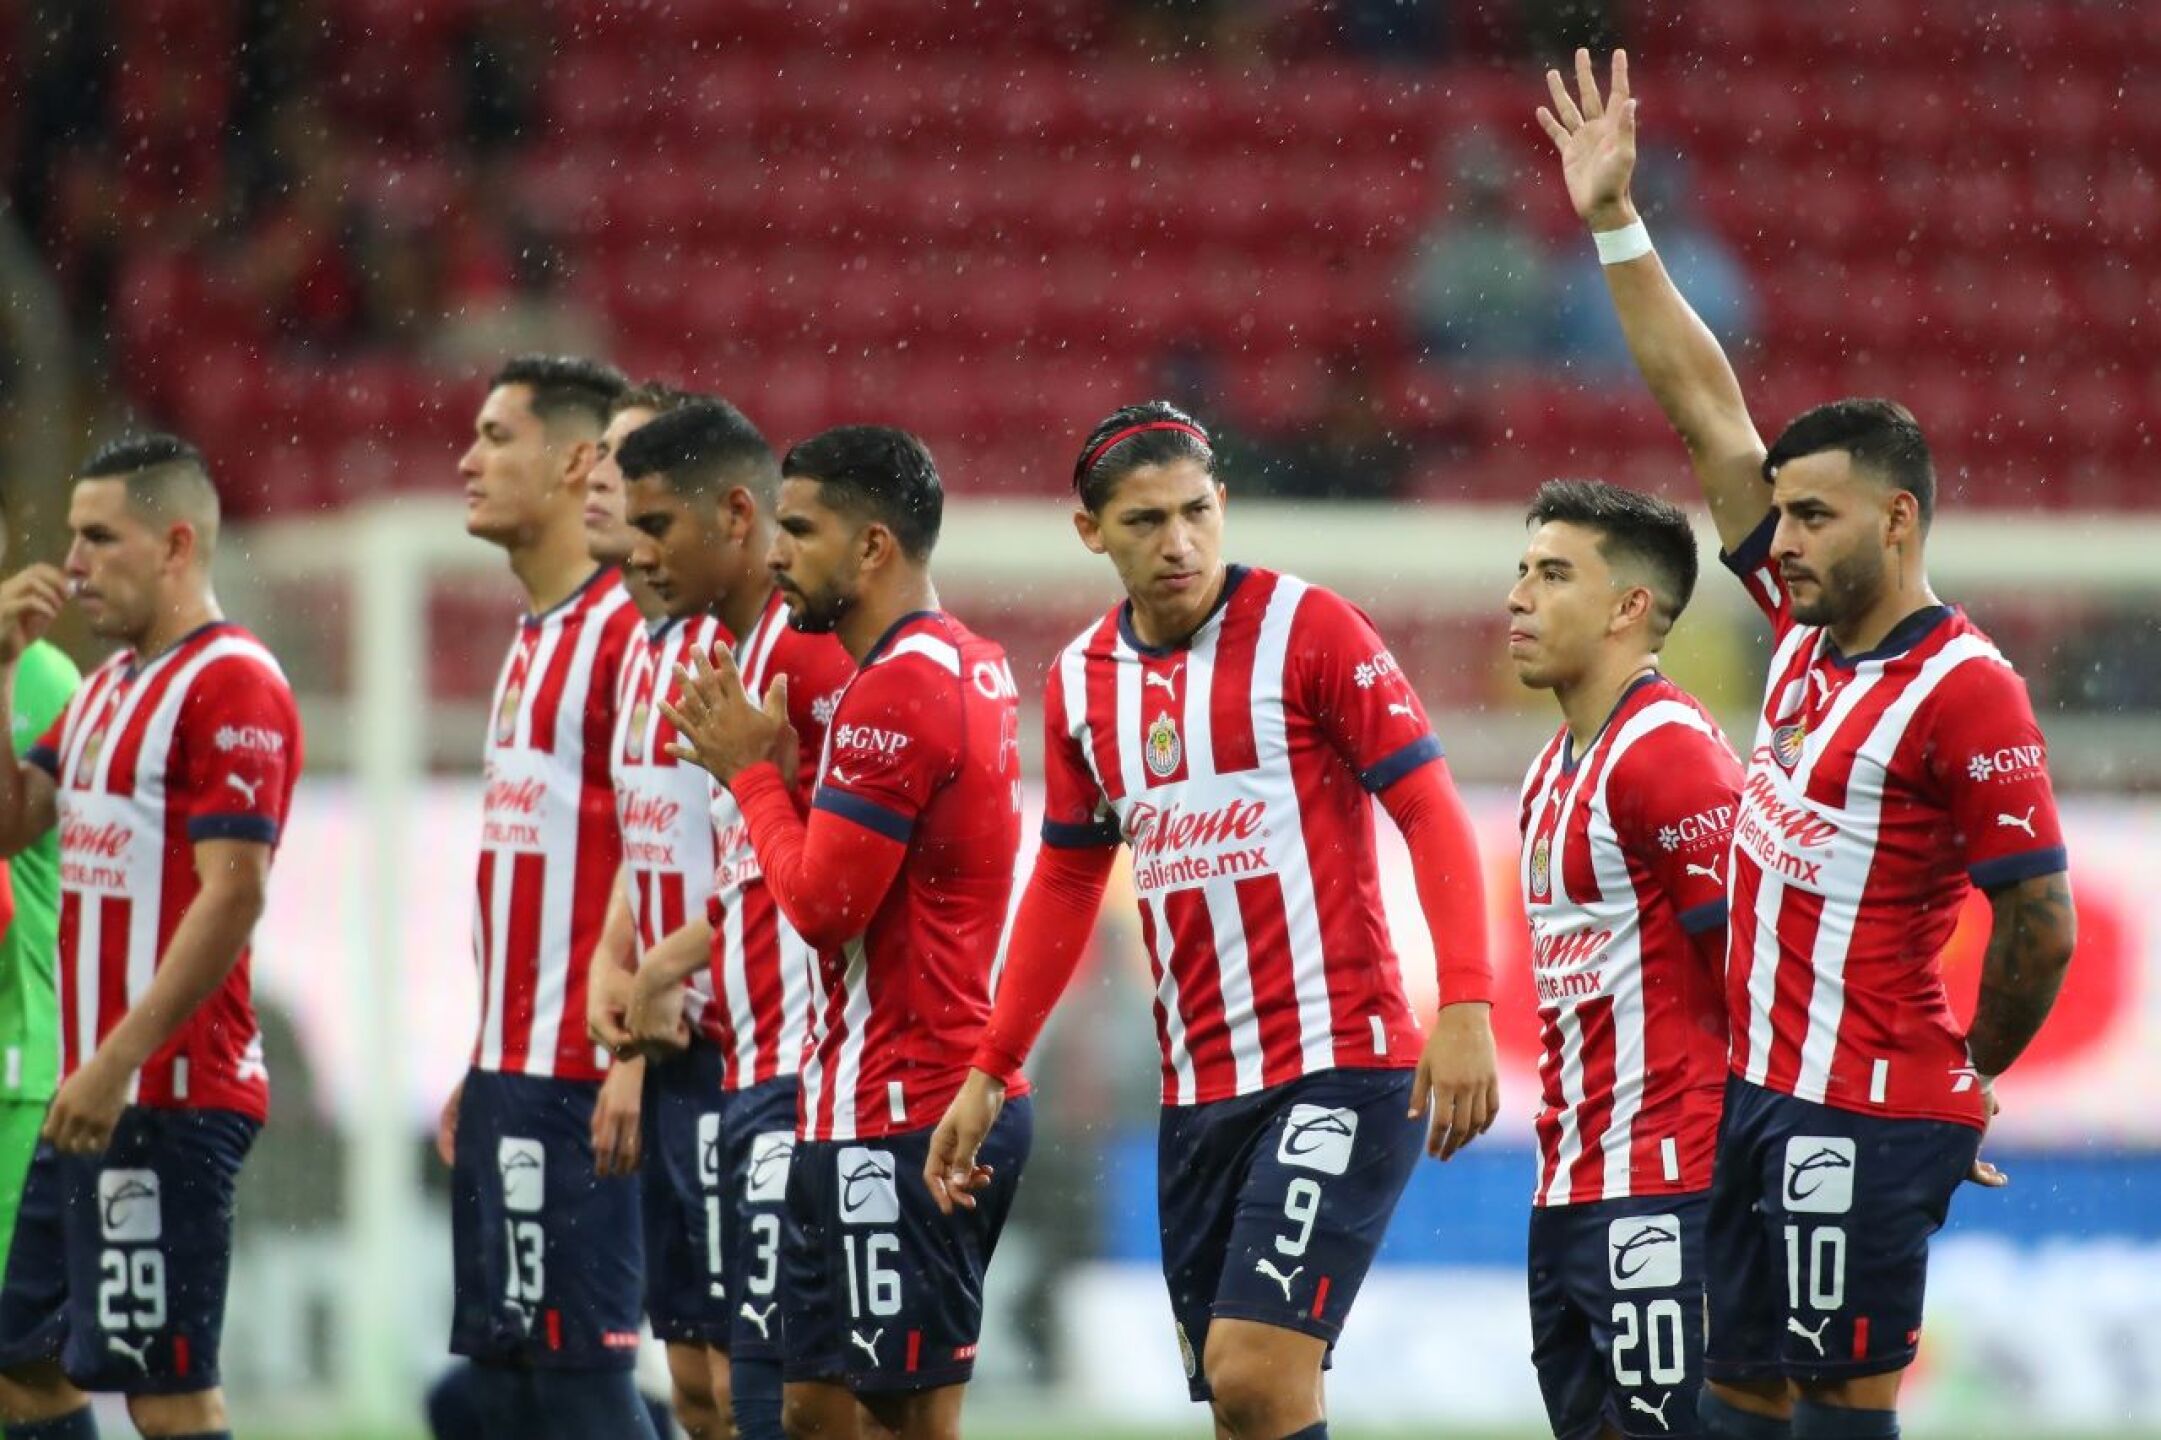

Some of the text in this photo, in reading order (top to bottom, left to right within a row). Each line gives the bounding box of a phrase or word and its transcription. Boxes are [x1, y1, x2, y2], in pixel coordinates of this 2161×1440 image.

[240, 725, 282, 753] GNP
[852, 726, 908, 754] GNP
[1993, 745, 2041, 772] GNP
[1127, 798, 1267, 864] Caliente
[1679, 806, 1732, 841] GNP
[748, 1214, 779, 1294] 3
[1275, 1178, 1321, 1257] 9
[100, 1250, 166, 1329] 29
[505, 1218, 544, 1301] 13
[843, 1234, 902, 1318] 16
[1784, 1225, 1847, 1311] 10
[1612, 1300, 1685, 1386] 20
